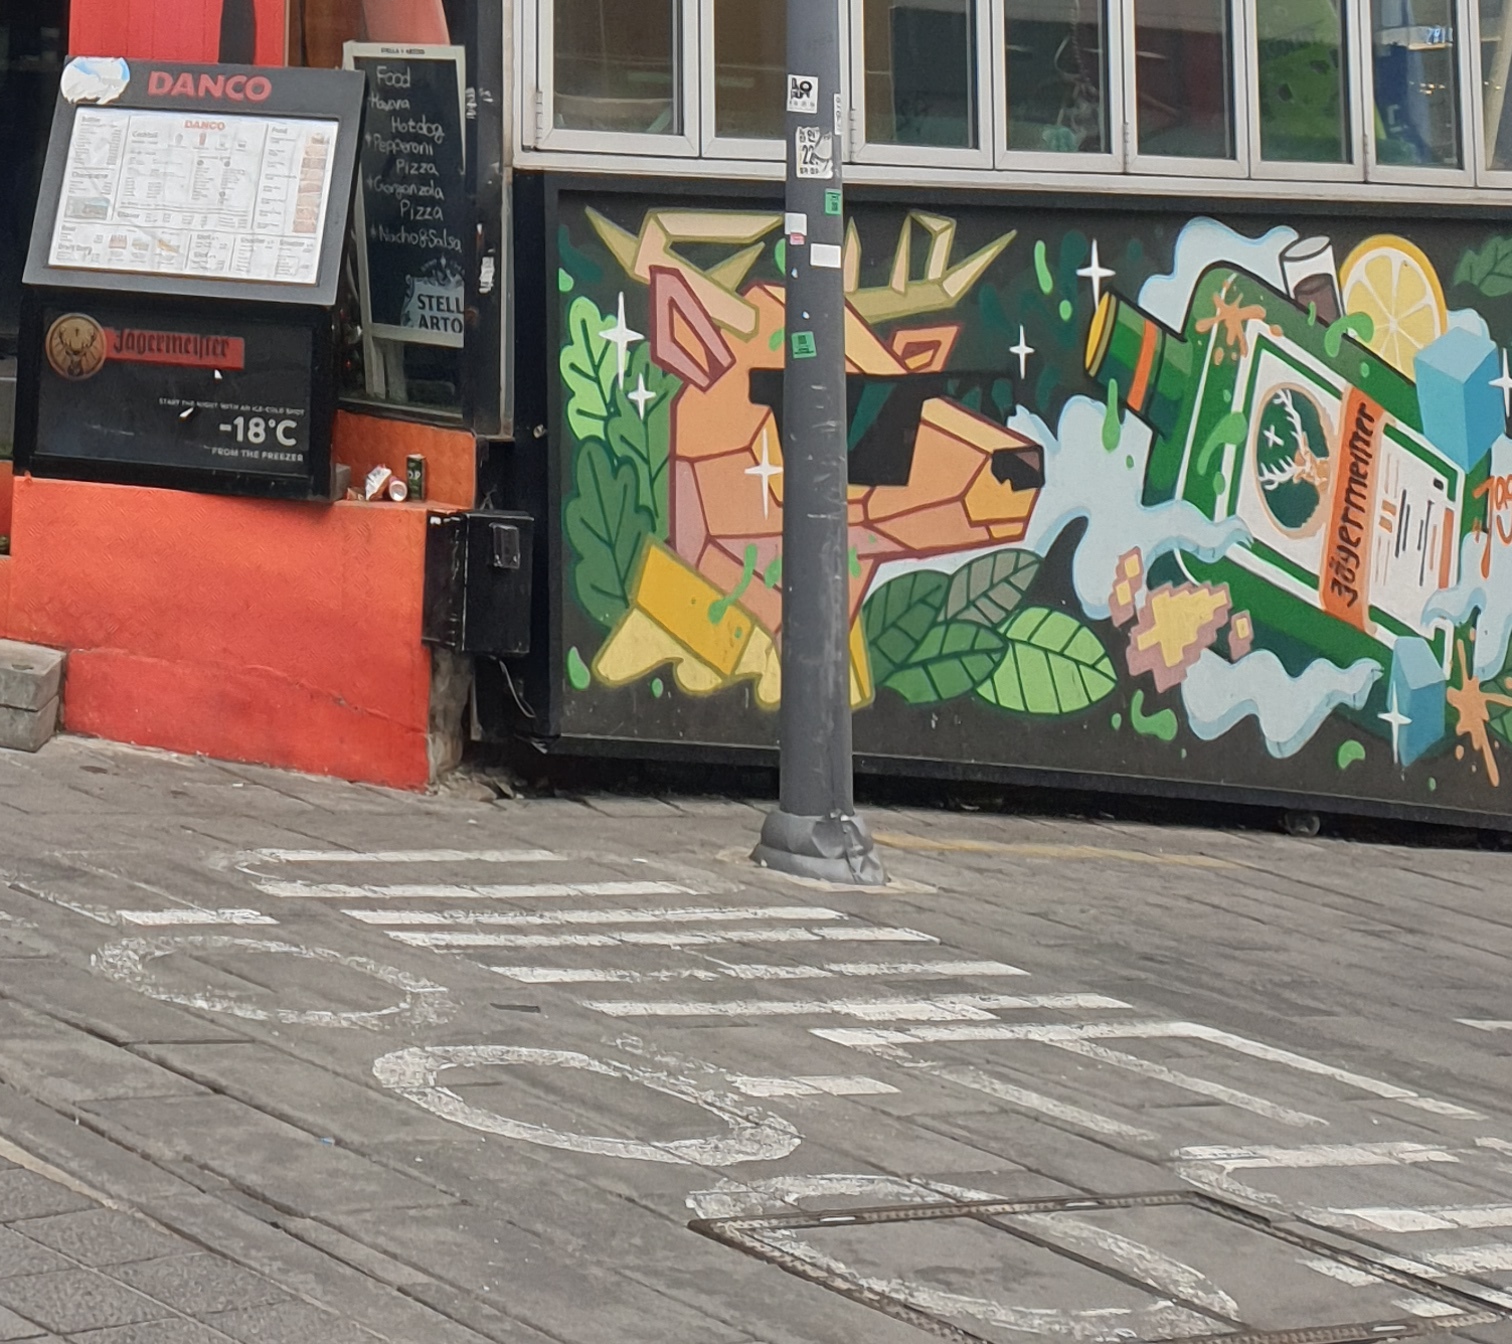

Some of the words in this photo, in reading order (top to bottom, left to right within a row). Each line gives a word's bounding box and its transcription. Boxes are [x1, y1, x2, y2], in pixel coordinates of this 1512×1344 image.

[147, 69, 274, 103] DANCO
[376, 65, 411, 88] Food
[184, 119, 226, 131] DANCO
[391, 114, 445, 144] Hotdog
[373, 132, 434, 157] Pepperoni
[396, 158, 439, 176] Pizza
[400, 199, 444, 221] Pizza
[219, 415, 298, 447] -18°C
[211, 447, 239, 457] FROM
[241, 449, 259, 459] THE
[261, 451, 304, 462] FREEZER
